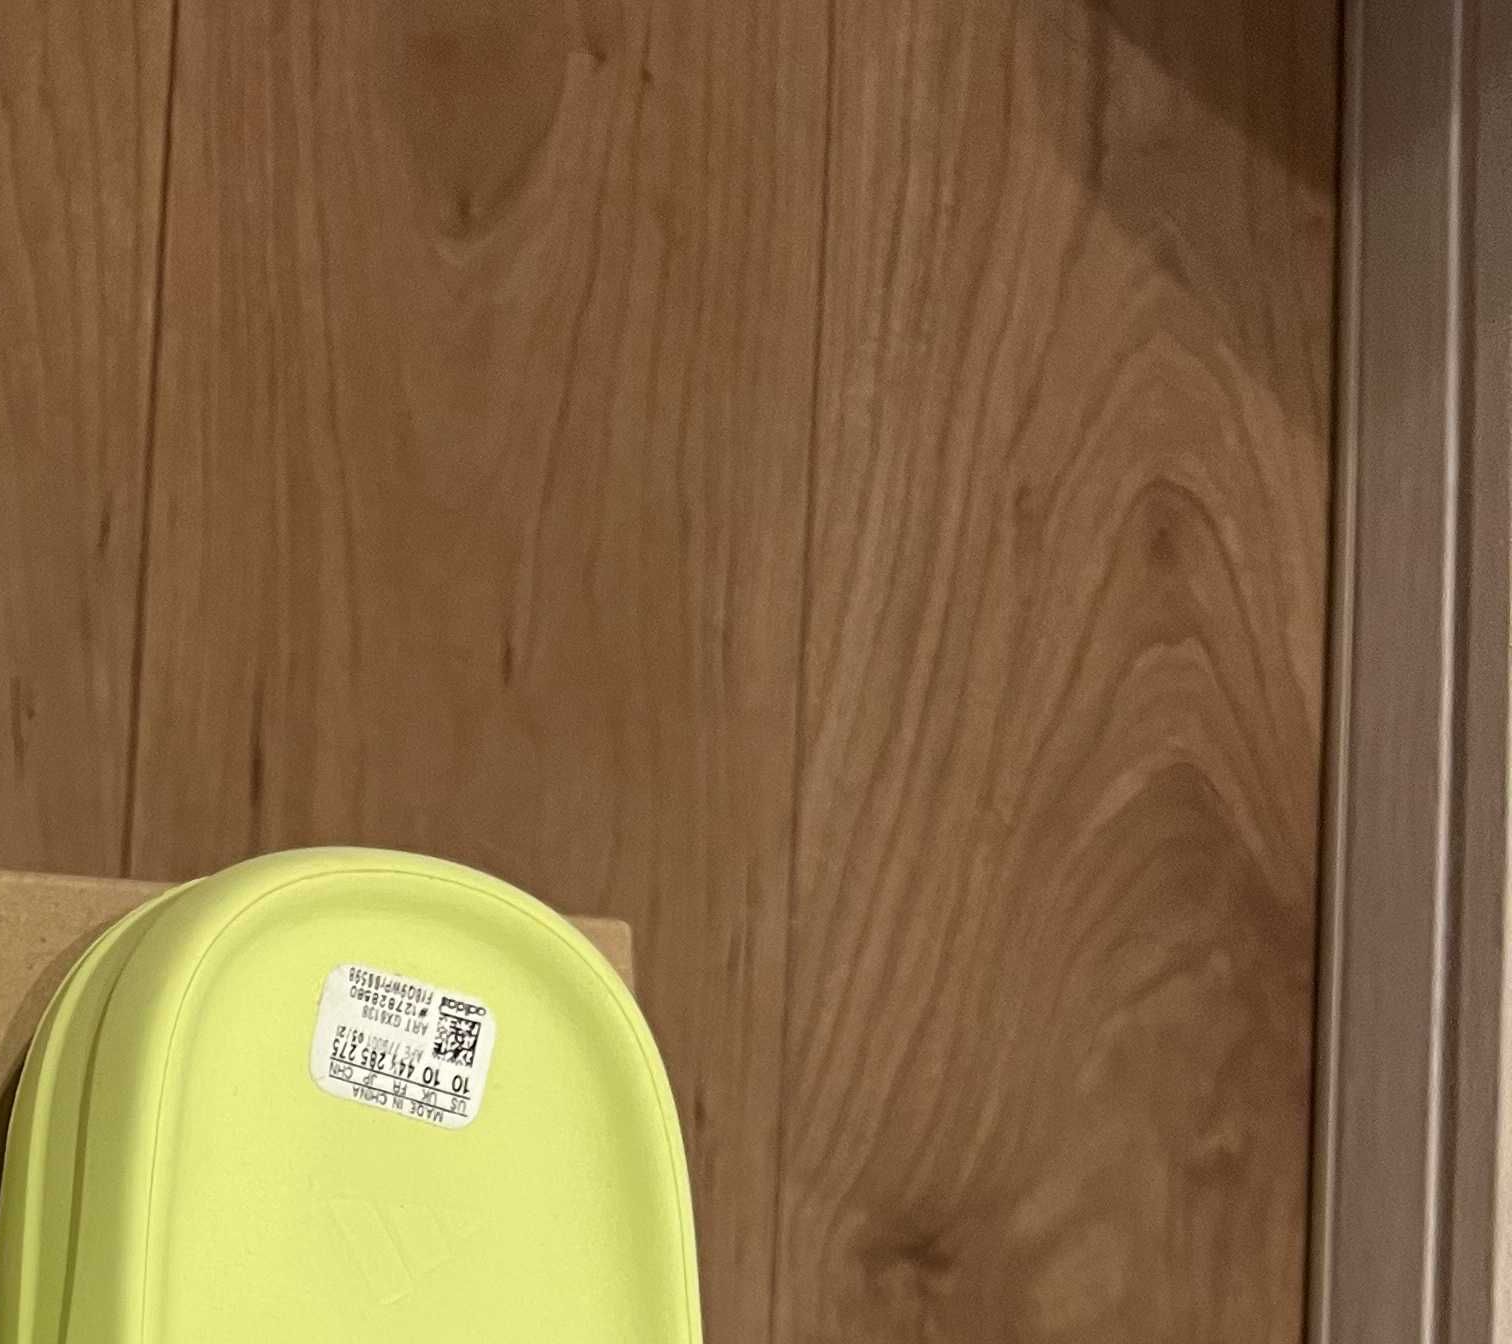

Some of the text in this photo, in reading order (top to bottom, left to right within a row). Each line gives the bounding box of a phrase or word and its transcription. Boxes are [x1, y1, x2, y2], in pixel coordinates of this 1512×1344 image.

[440, 997, 486, 1016] adidas
[405, 1019, 429, 1035] ART
[332, 1039, 356, 1061] 275
[361, 1048, 385, 1069] 285
[423, 1067, 440, 1085] 10
[451, 1075, 470, 1094] 10
[330, 1062, 466, 1112] US UK FR JP CHN
[352, 1087, 443, 1122] MADE IN CHINA
